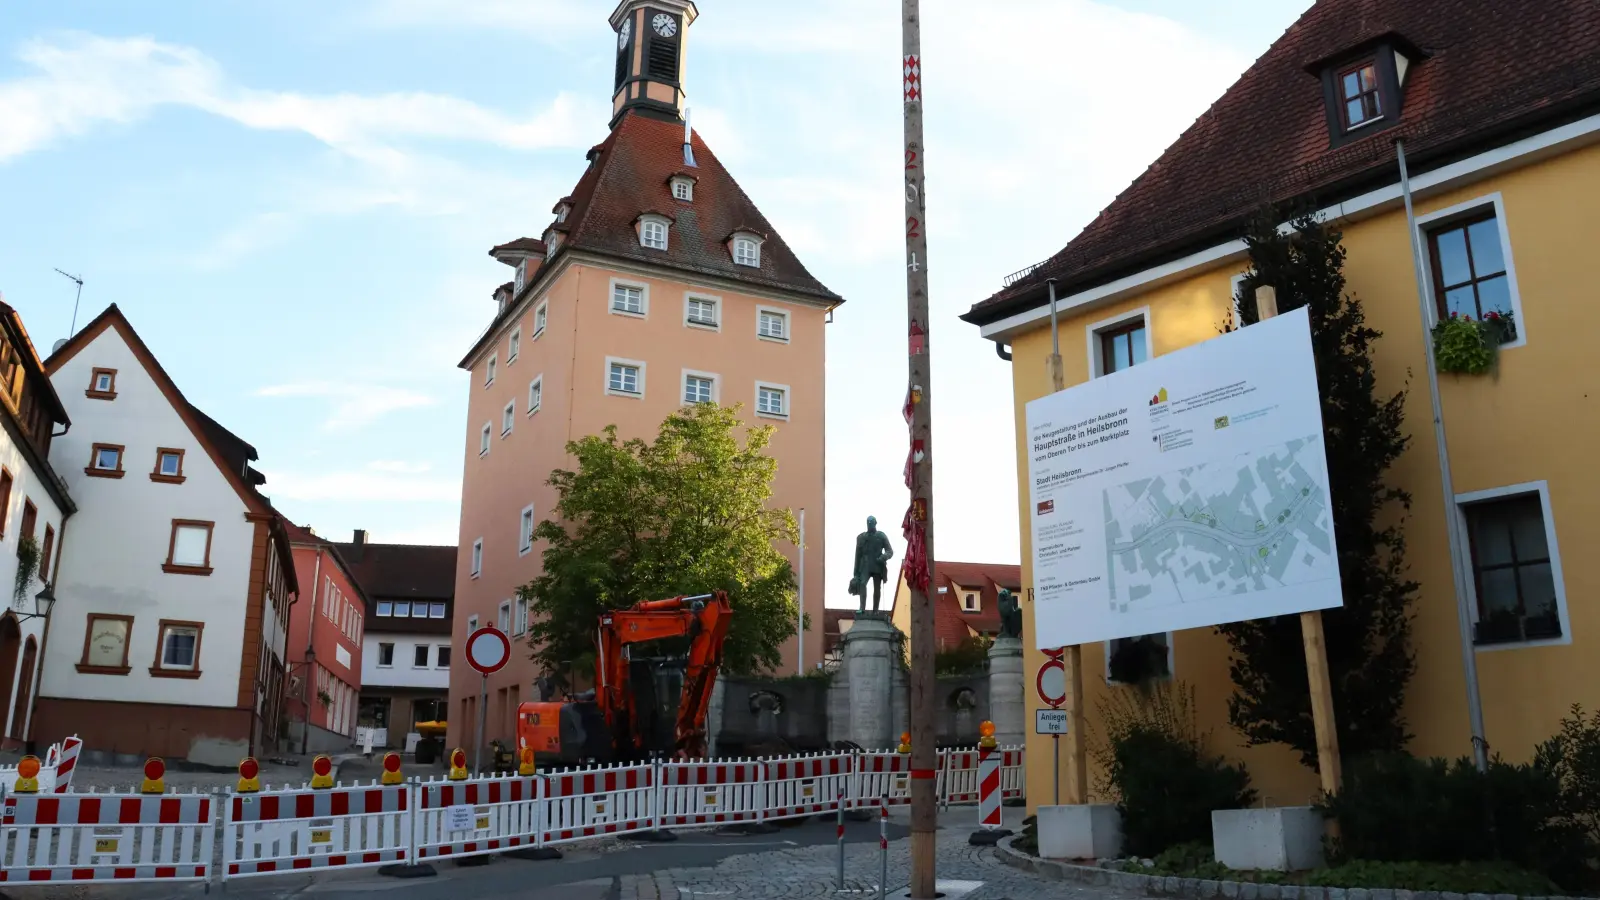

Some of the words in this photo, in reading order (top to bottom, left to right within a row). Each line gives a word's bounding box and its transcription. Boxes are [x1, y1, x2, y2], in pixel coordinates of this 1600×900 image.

[1034, 433, 1077, 453] Hauptstraße
[1078, 430, 1085, 439] in
[1087, 417, 1128, 436] Heilsbronn
[1042, 424, 1077, 440] Neugestaltung
[1097, 411, 1118, 422] Ausbau
[1047, 448, 1066, 458] Oberen
[1100, 429, 1130, 444] Marktplatz
[1036, 476, 1051, 485] Stadt
[1051, 468, 1082, 481] Heilsbronn
[1048, 722, 1060, 730] frei
